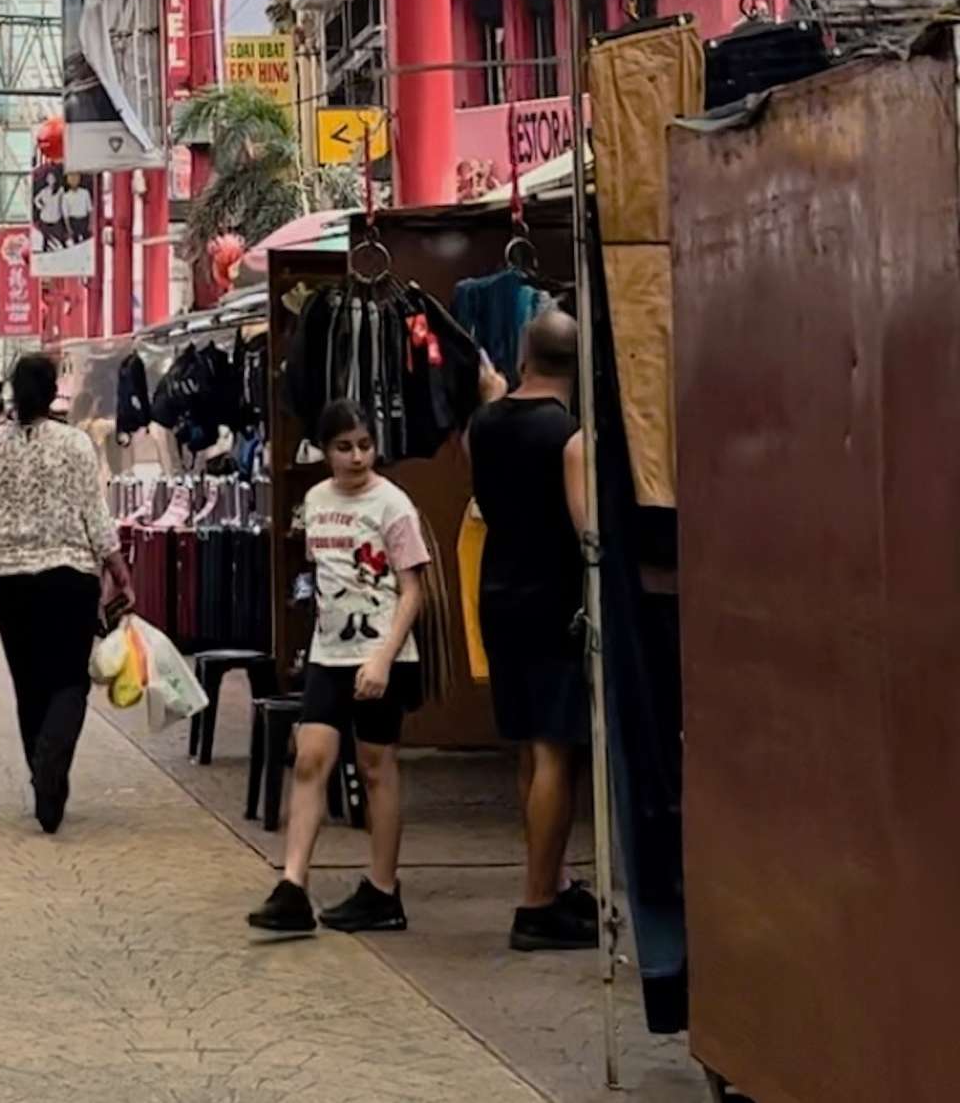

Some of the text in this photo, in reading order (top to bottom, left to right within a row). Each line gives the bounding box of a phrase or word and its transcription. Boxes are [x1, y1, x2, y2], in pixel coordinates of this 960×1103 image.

[229, 43, 285, 58] EDAI UBAT
[229, 62, 289, 82] EEN HING
[512, 110, 576, 163] ESTORA
